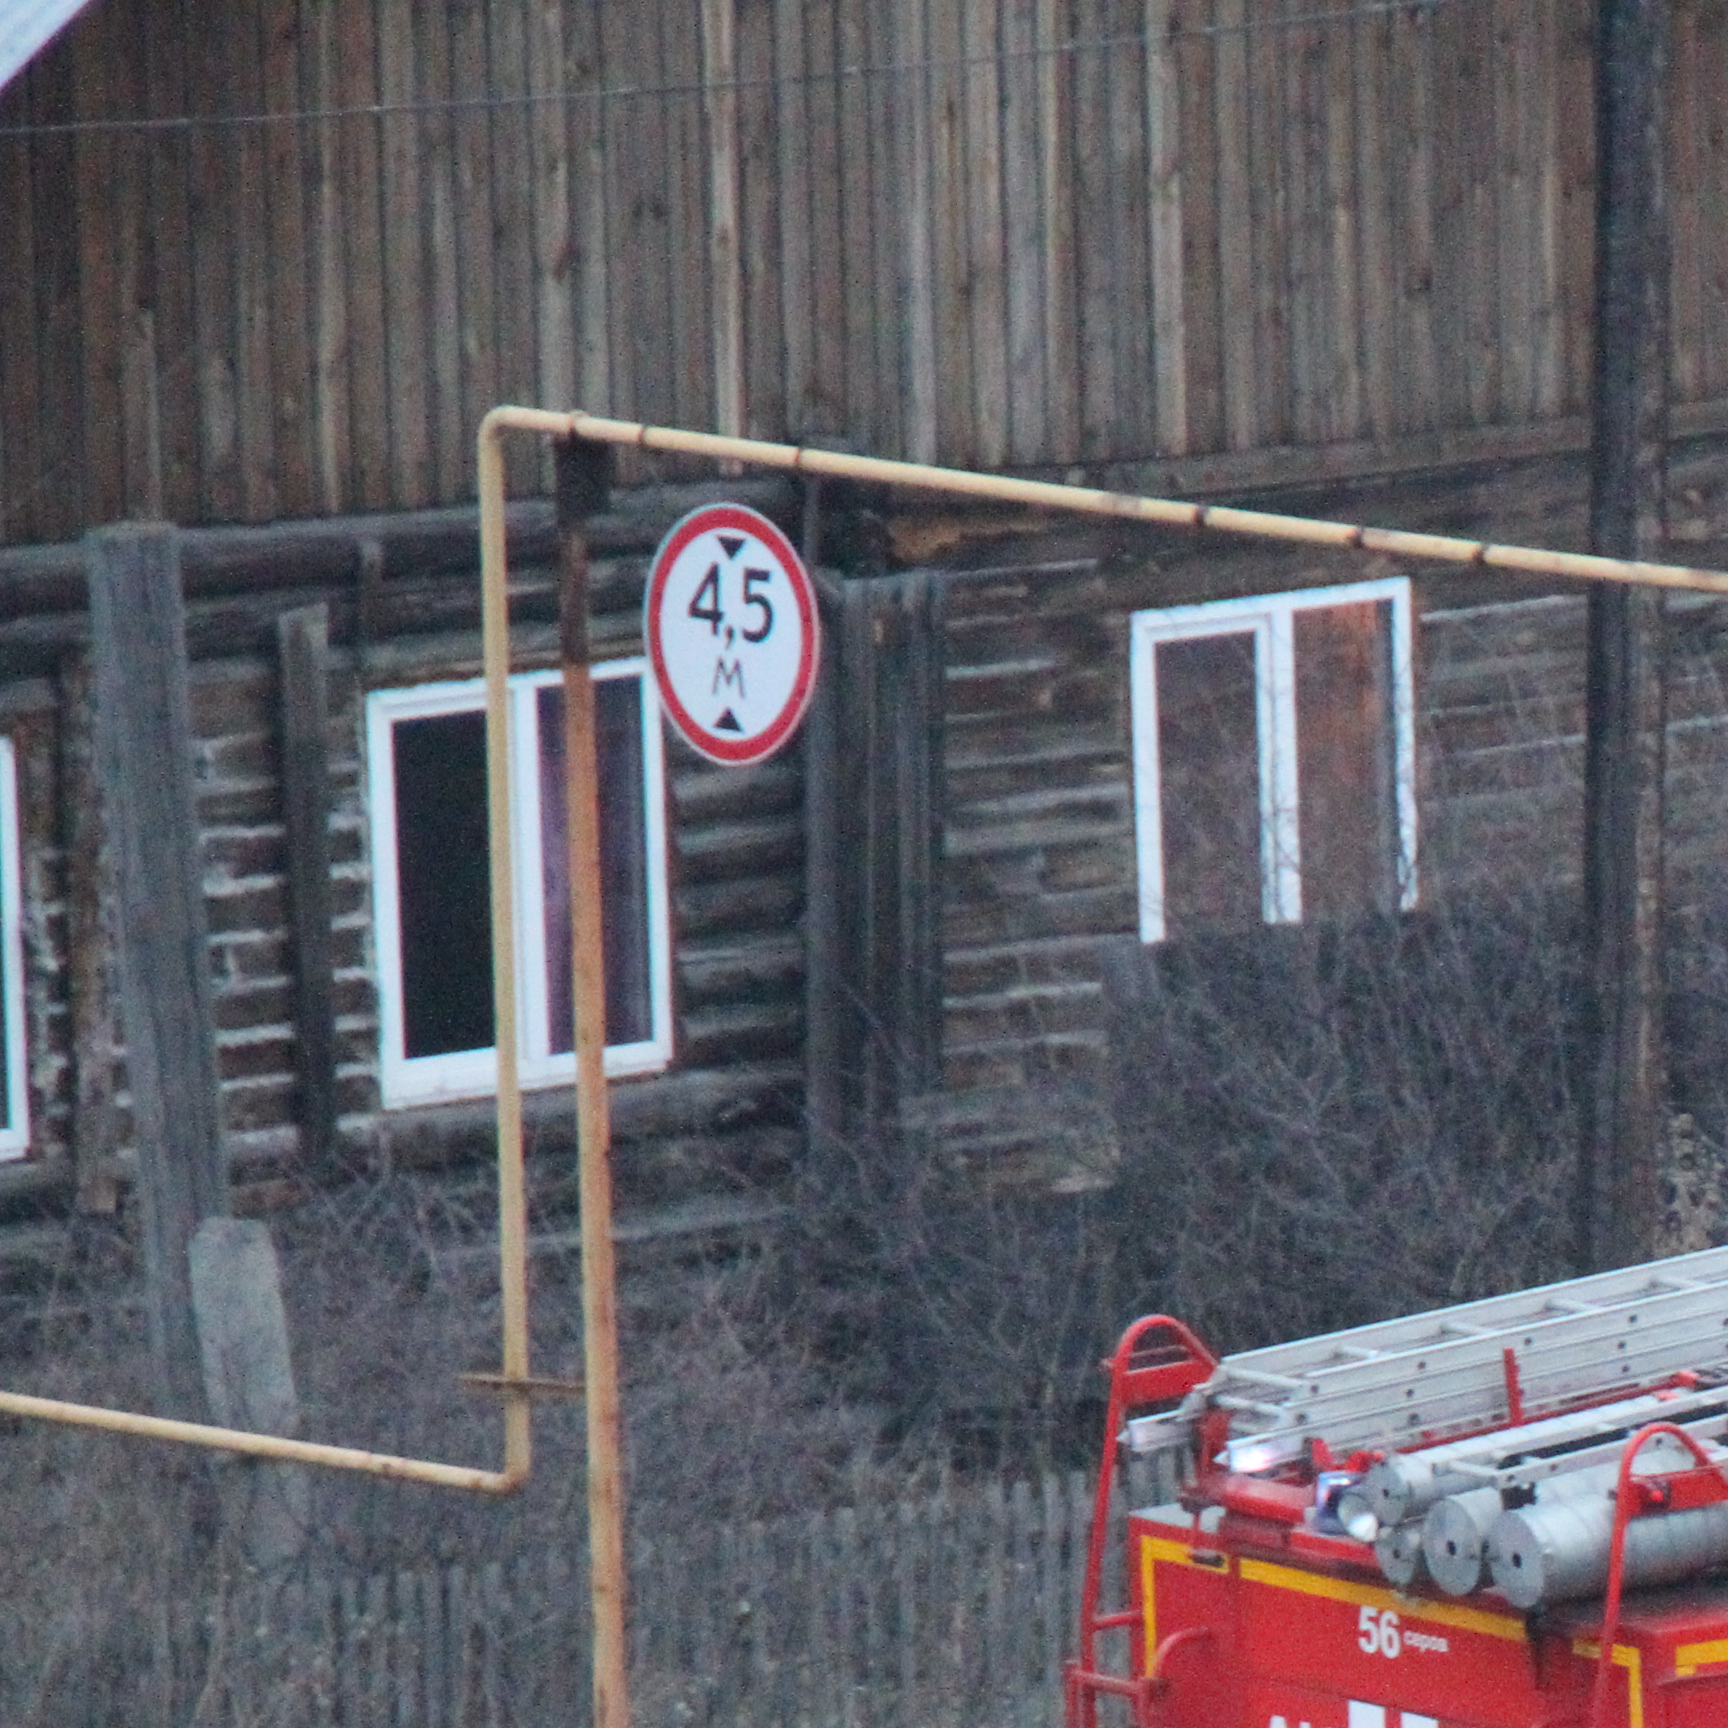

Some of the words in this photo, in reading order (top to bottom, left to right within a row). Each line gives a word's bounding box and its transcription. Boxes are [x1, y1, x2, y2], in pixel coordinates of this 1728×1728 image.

[688, 561, 774, 649] 4,5
[711, 655, 745, 699] М
[1358, 1605, 1401, 1659] 56
